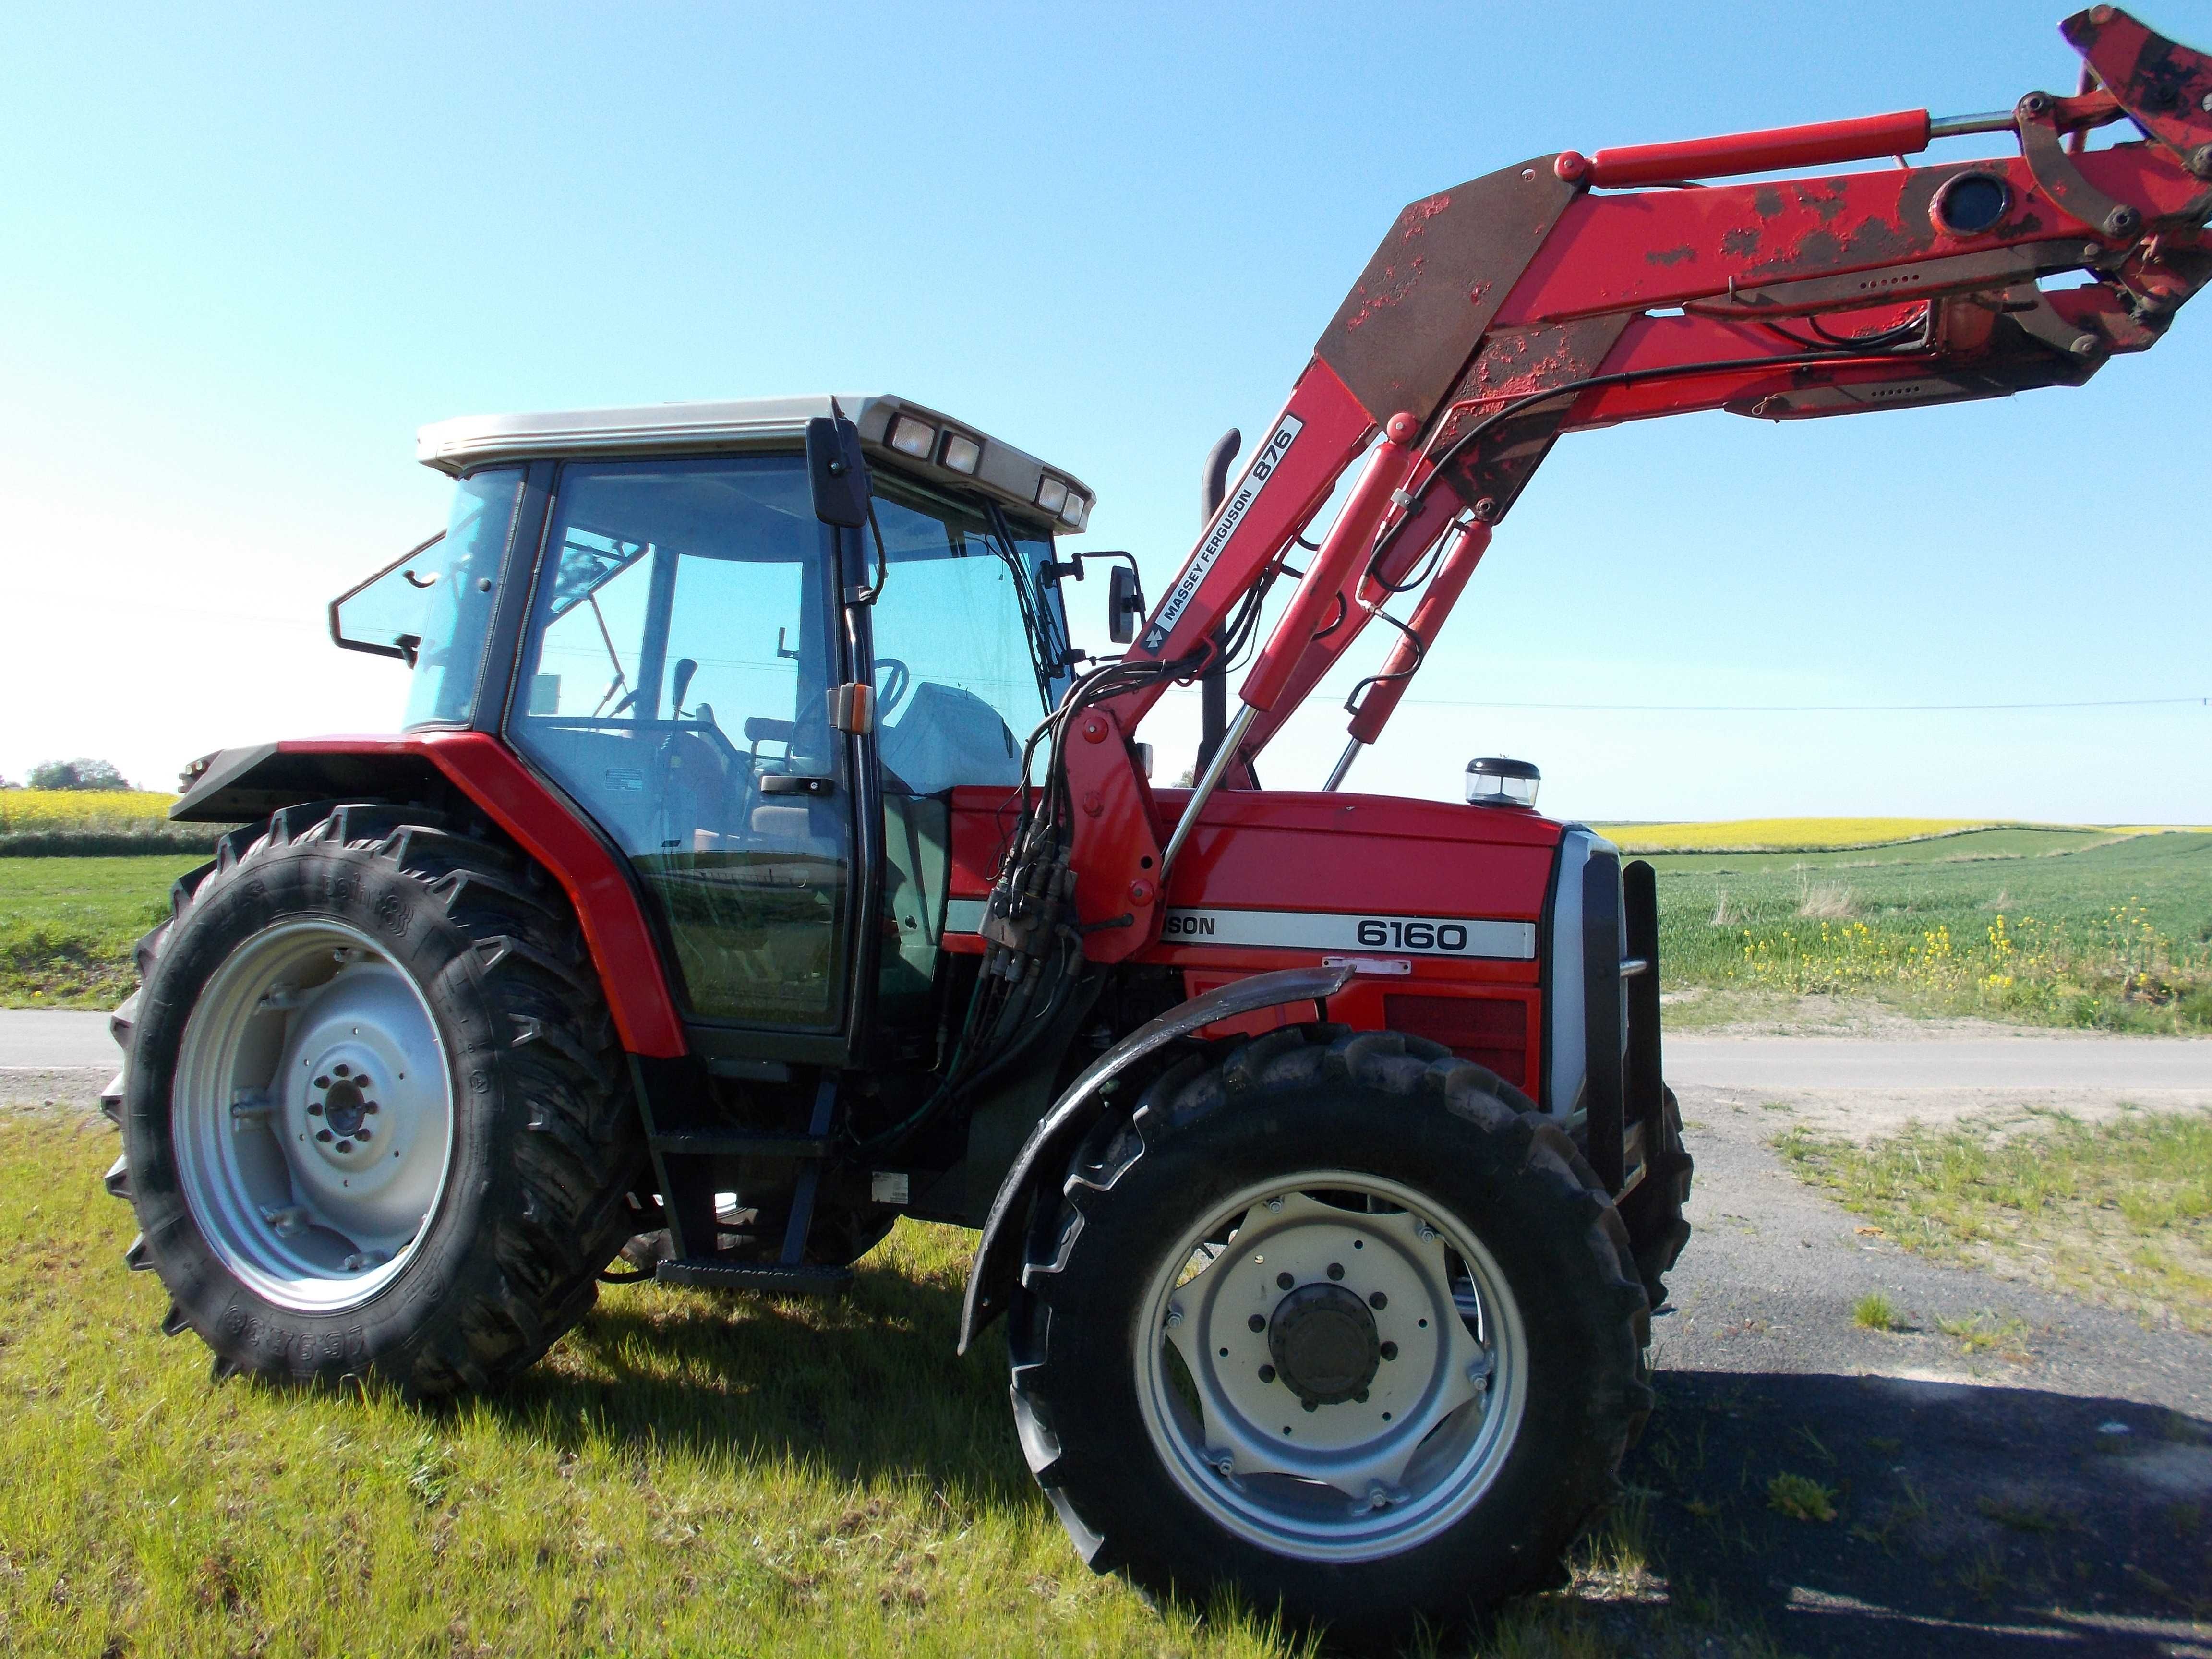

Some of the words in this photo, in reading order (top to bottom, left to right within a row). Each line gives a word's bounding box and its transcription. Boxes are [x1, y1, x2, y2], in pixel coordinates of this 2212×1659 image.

[1164, 562, 1203, 621] MASSEY
[1201, 489, 1252, 563] FERGUSON
[1253, 429, 1292, 481] 876
[1163, 916, 1215, 935] SON
[1358, 920, 1467, 950] 6160
